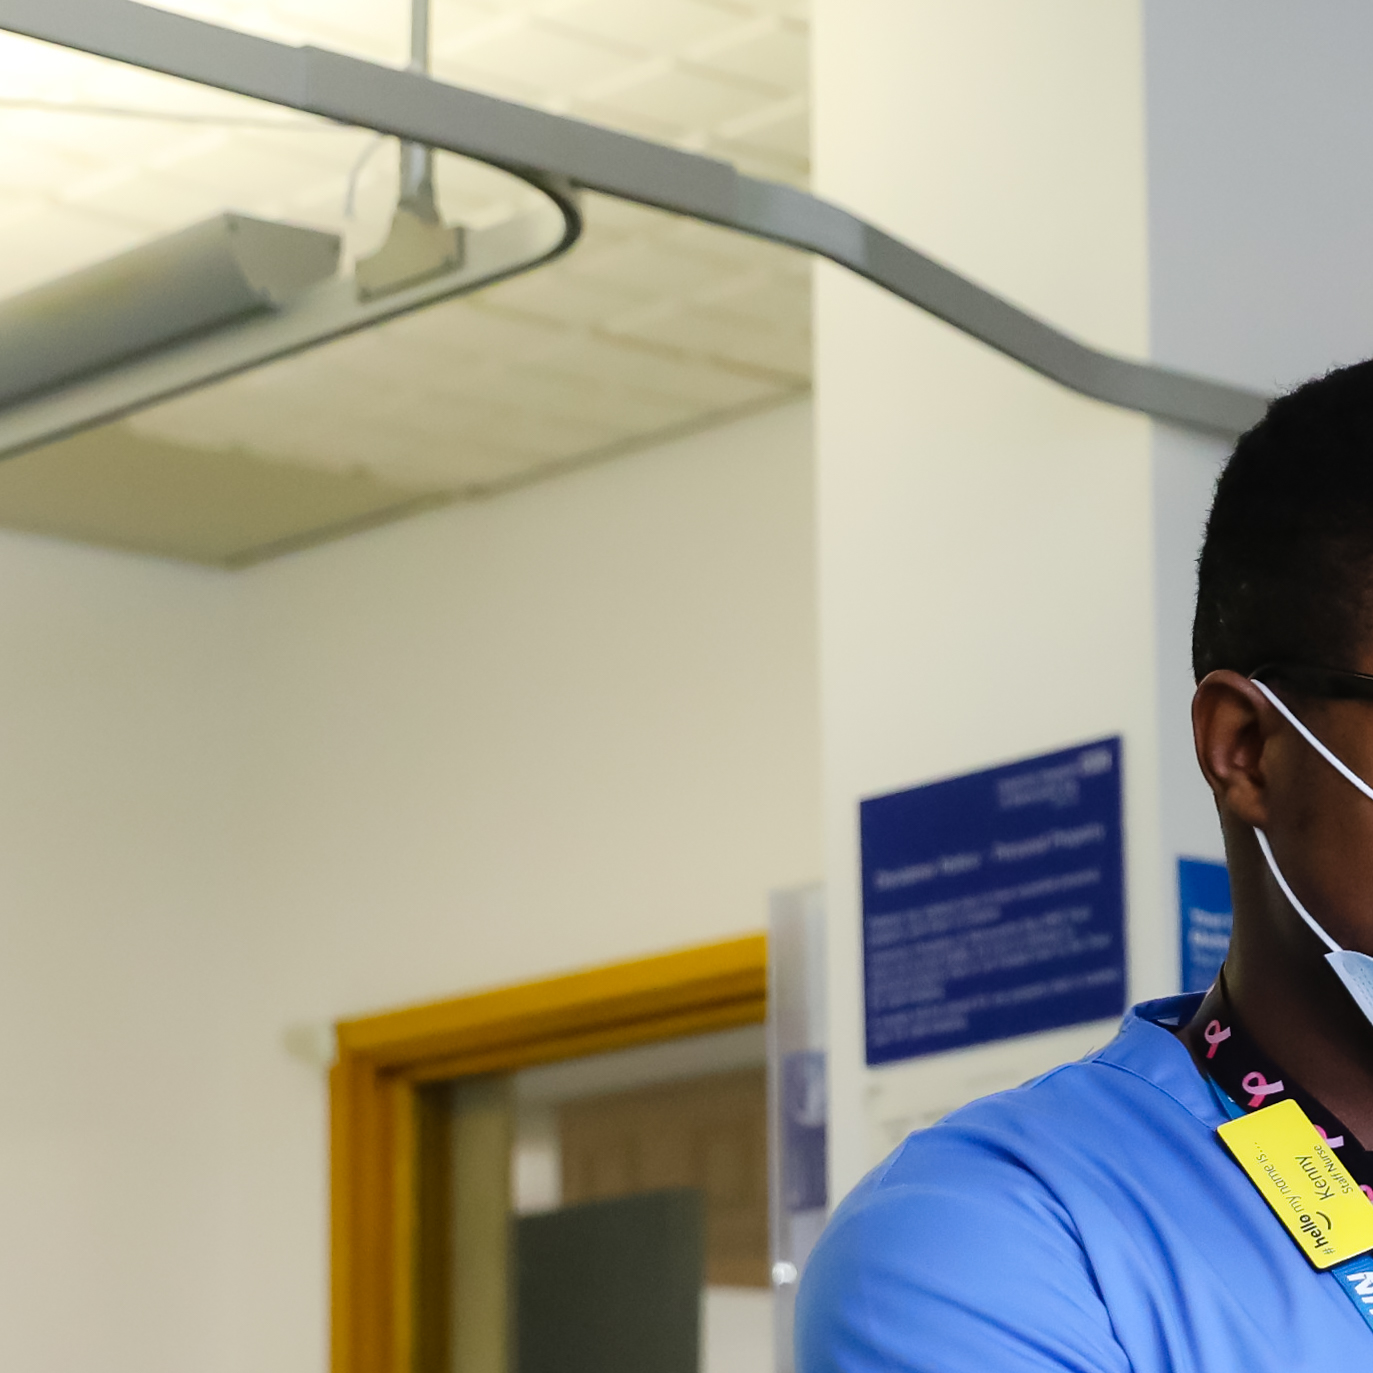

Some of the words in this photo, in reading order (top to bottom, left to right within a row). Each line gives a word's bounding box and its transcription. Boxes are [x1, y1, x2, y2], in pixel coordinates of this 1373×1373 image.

[1313, 1145, 1338, 1172] Nurse
[1263, 1165, 1291, 1194] name
[1295, 1155, 1335, 1201] Kenny
[1333, 1171, 1354, 1194] Staff
[1286, 1195, 1305, 1213] my
[1299, 1213, 1336, 1255] #hello
